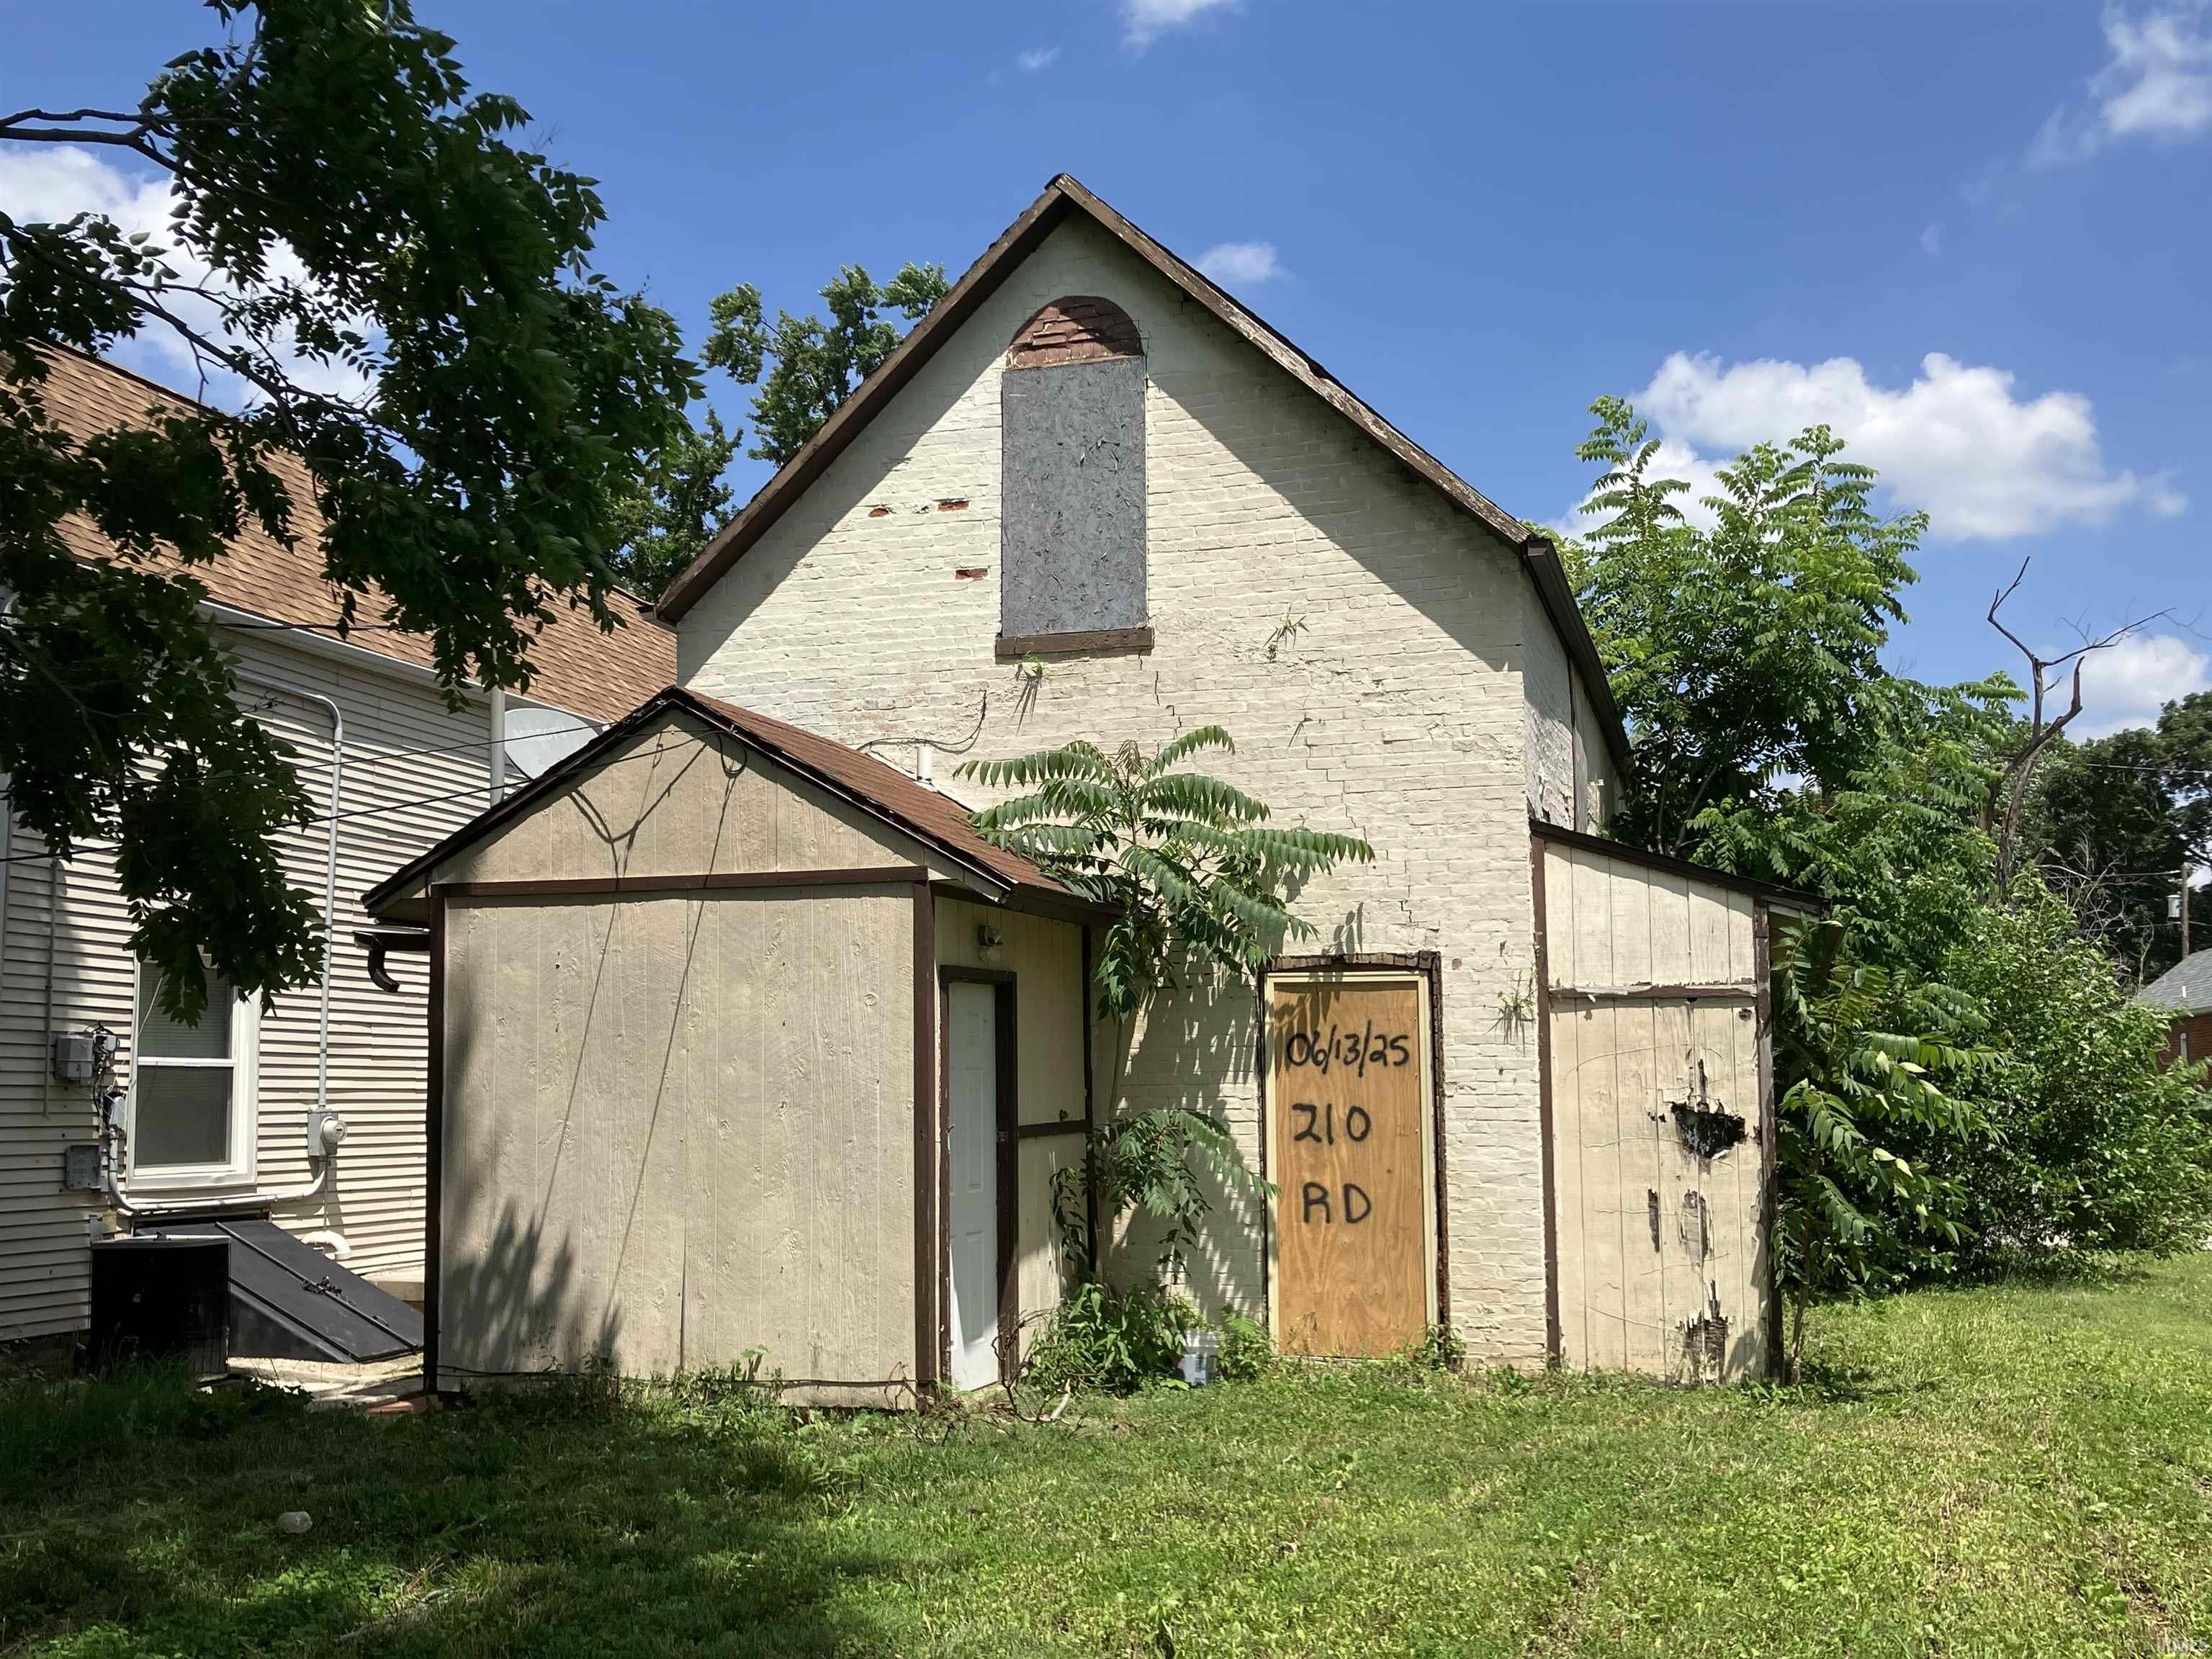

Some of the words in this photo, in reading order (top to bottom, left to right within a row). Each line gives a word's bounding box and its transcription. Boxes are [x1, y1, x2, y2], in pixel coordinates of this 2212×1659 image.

[1286, 1020, 1409, 1077] 06/13/25
[1292, 1103, 1371, 1146] 210
[1303, 1182, 1371, 1223] RD
